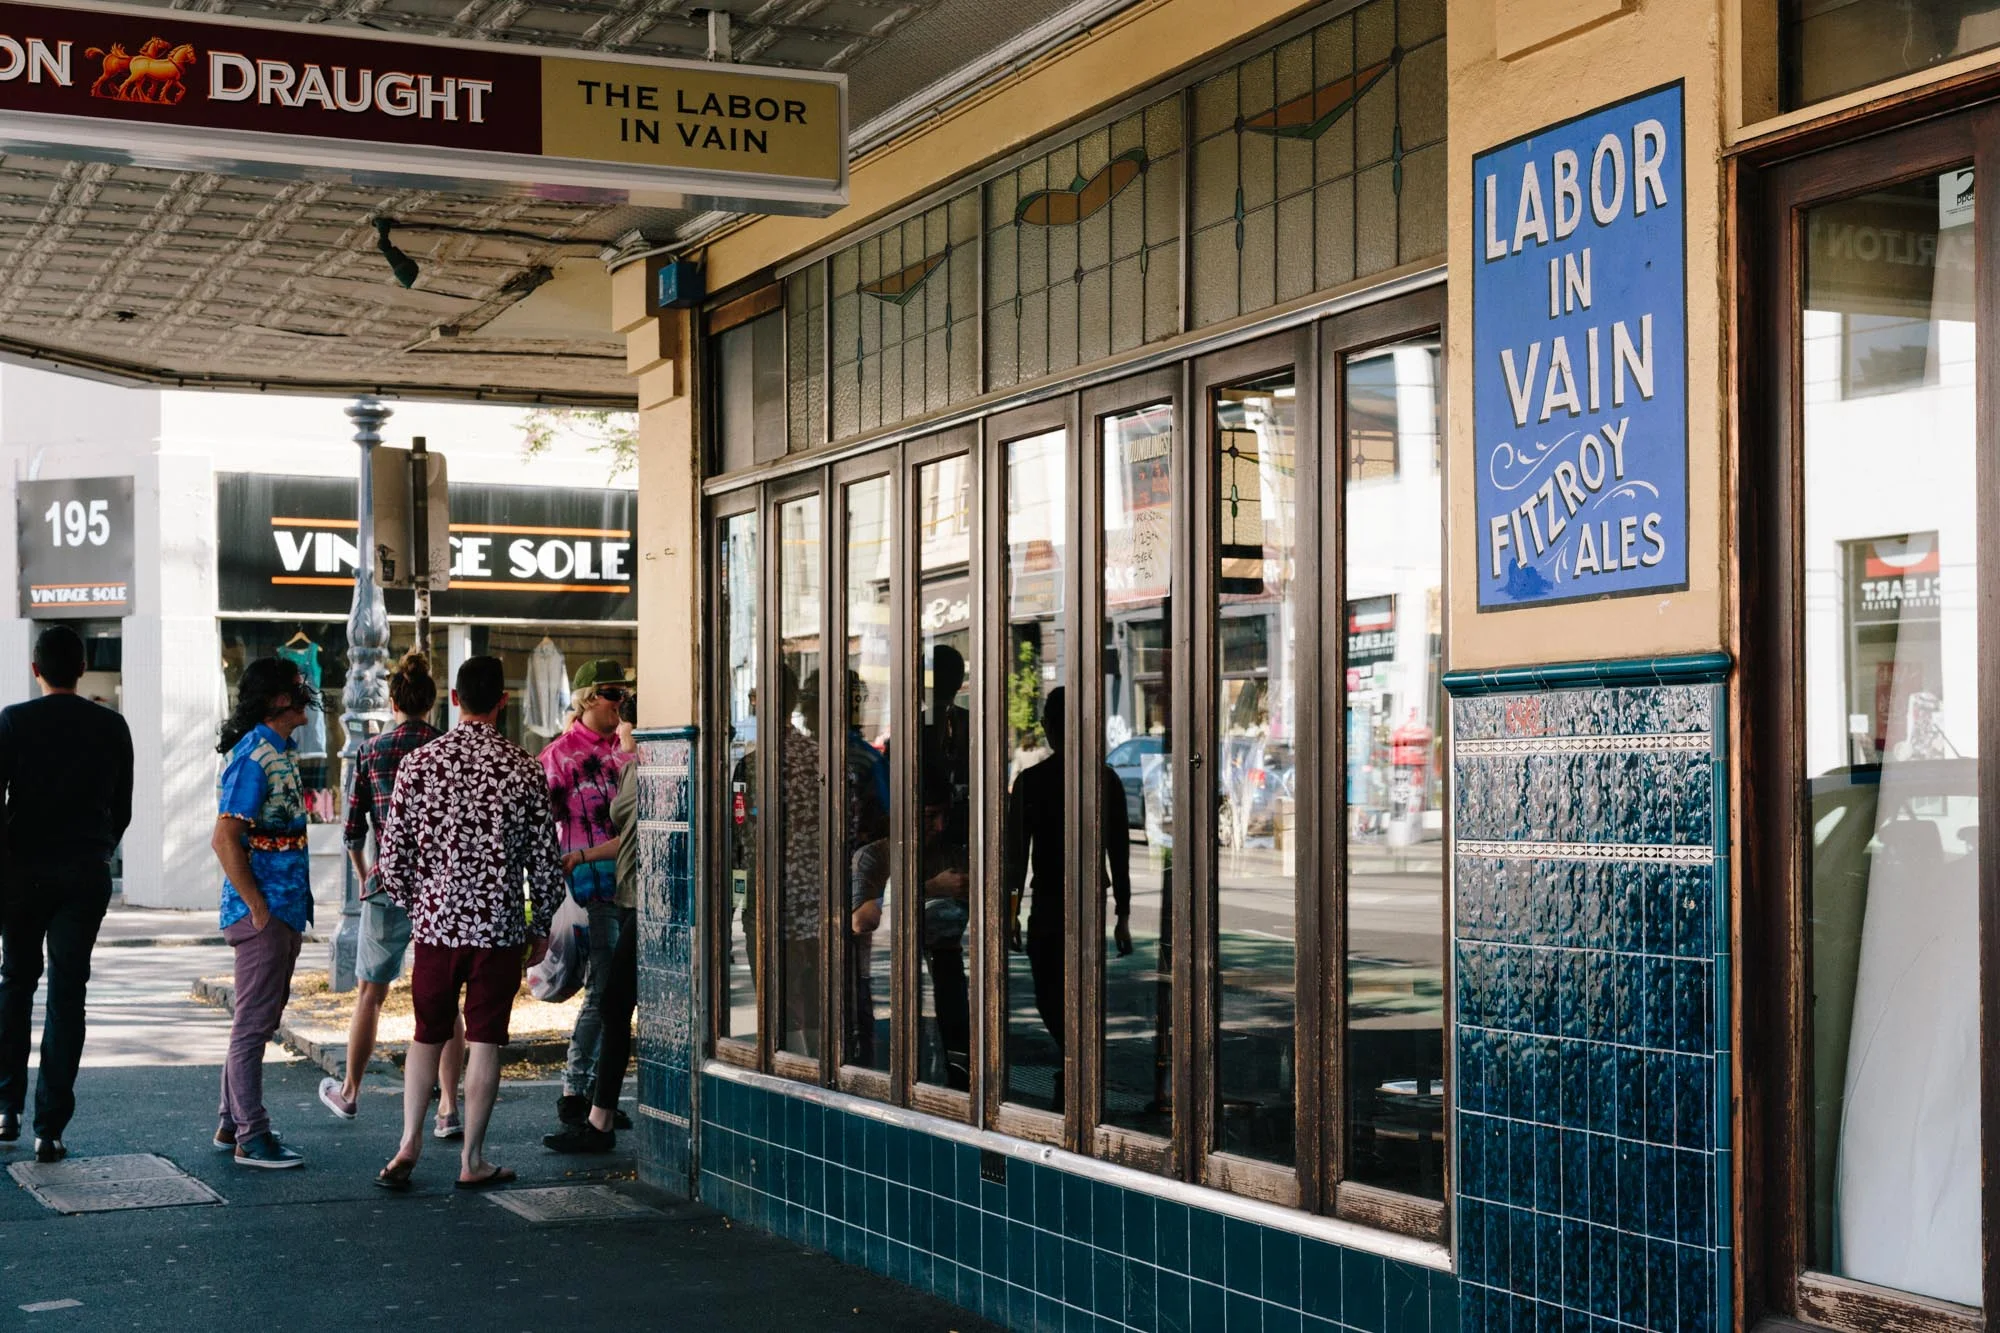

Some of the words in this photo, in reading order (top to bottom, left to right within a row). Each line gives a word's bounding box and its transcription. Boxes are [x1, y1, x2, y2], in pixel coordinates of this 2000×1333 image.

[0, 34, 74, 87] ON
[207, 50, 492, 123] DRAUGHT
[577, 80, 659, 111] THE
[677, 89, 808, 125] LABOR
[620, 118, 659, 145] IN
[676, 123, 768, 153] VAIN
[1485, 119, 1667, 262] LABOR
[1550, 248, 1591, 319] IN
[1501, 313, 1653, 427] VAIN
[45, 500, 110, 547] 195
[1490, 417, 1629, 578] FITZROY
[509, 539, 630, 580] SOLE
[1573, 512, 1665, 578] ALES
[31, 588, 89, 602] VINTAGE
[92, 586, 127, 601] SOLE
